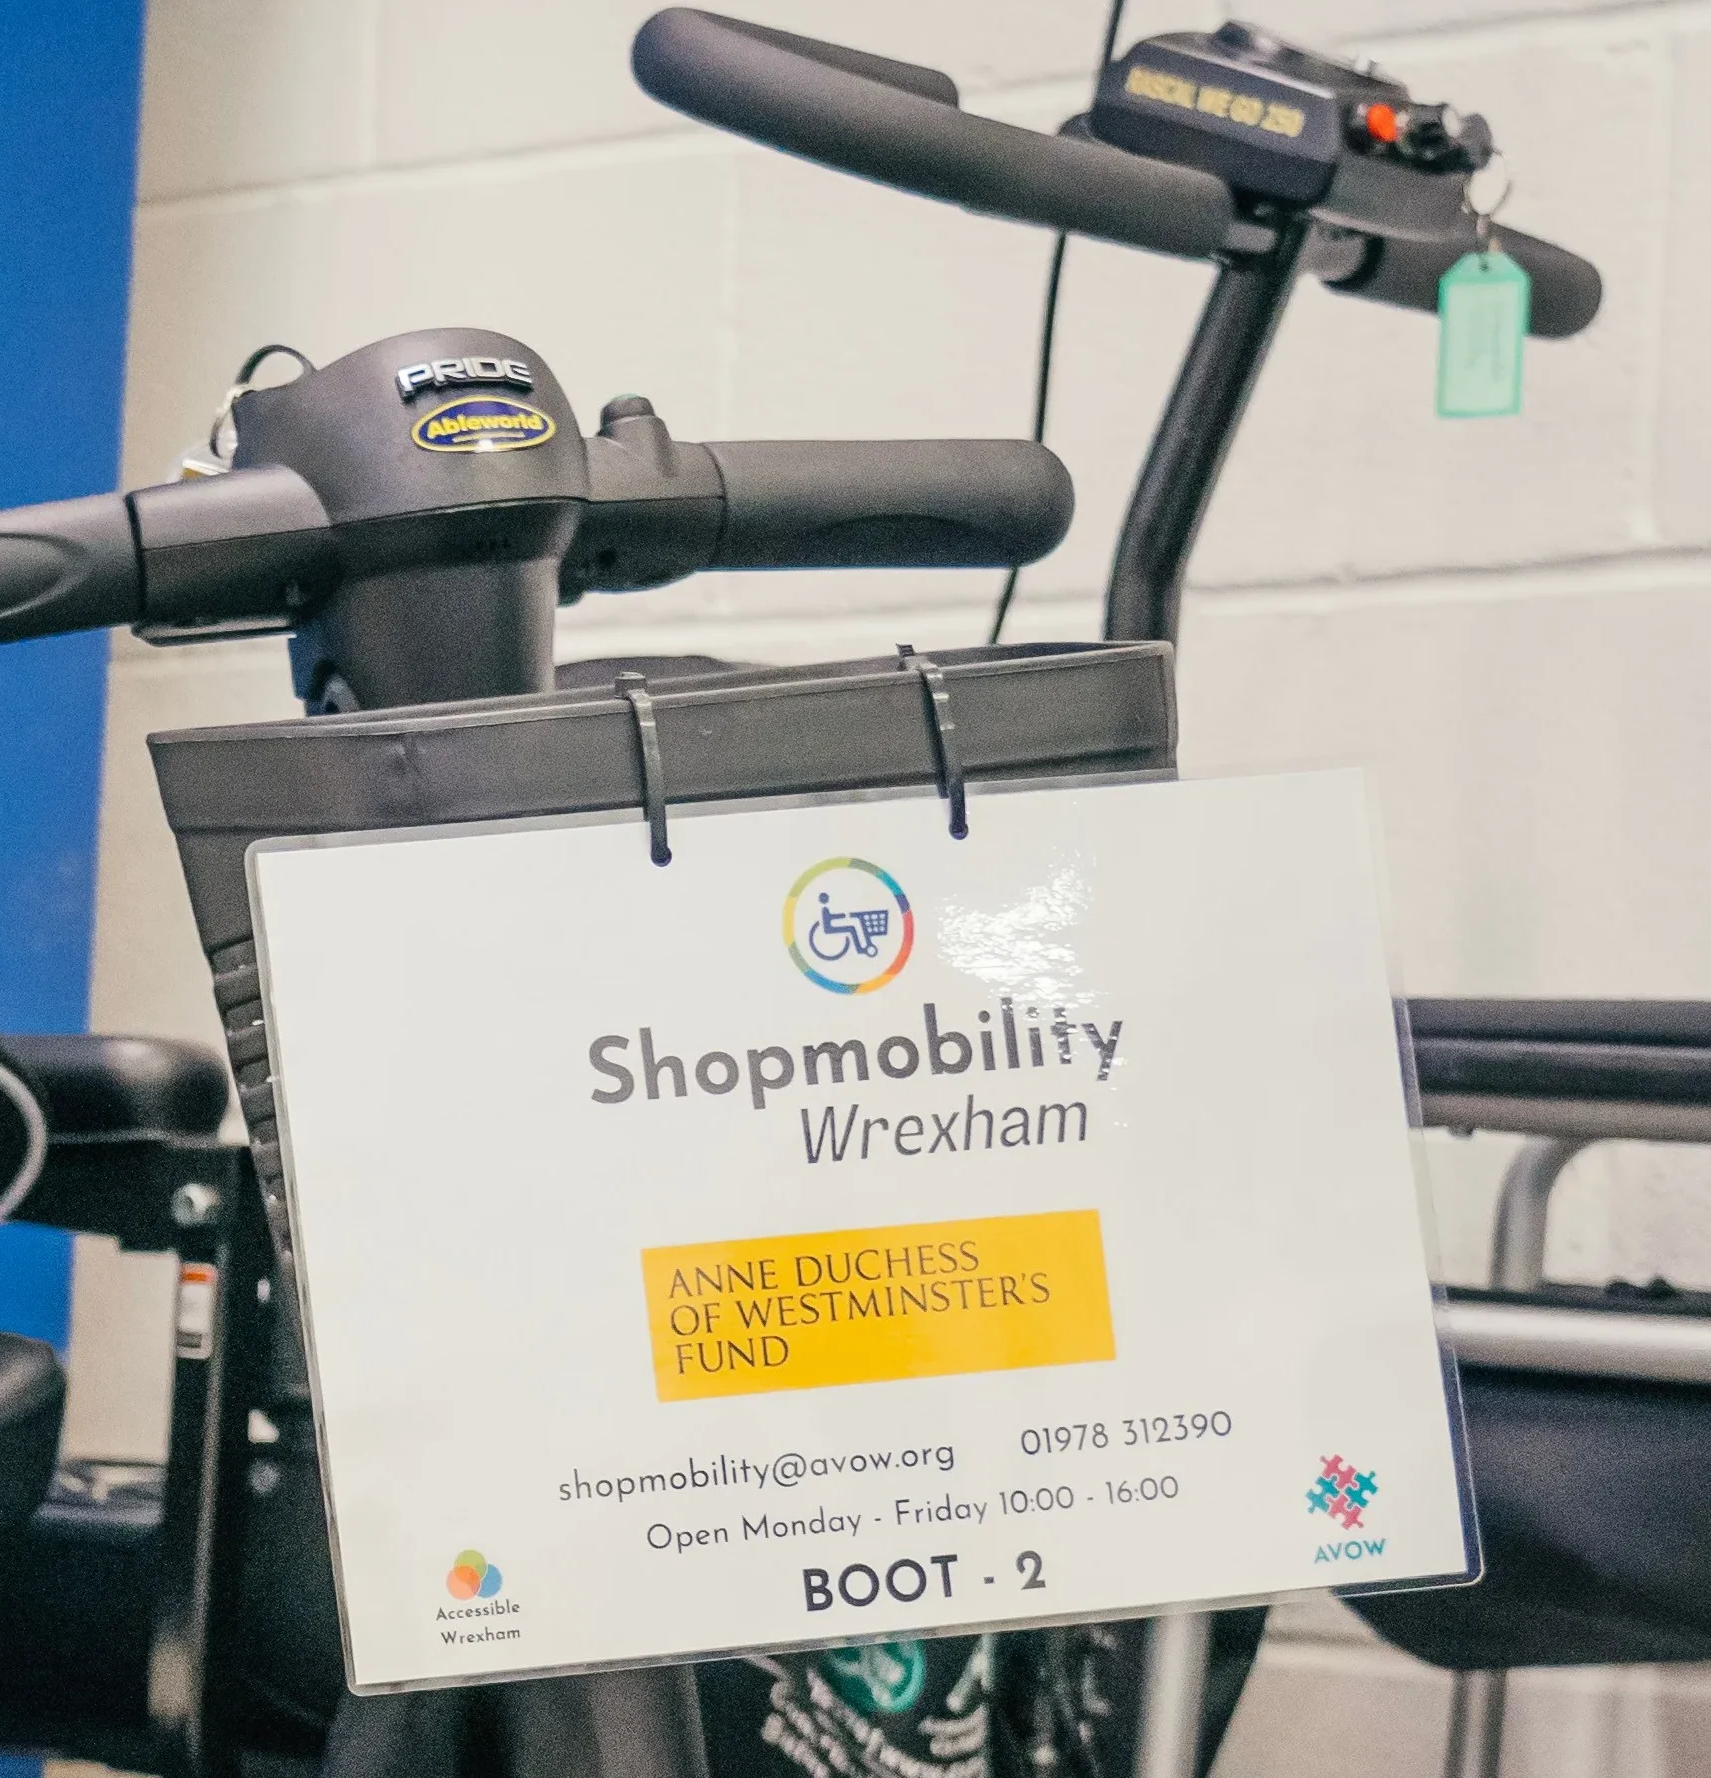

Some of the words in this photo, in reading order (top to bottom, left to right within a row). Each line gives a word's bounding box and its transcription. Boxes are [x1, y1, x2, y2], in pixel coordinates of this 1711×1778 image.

[397, 356, 535, 398] PRIDE
[427, 413, 544, 439] Ableworld
[588, 996, 1124, 1110] Shopmobility
[800, 1093, 1088, 1164] Wrexham
[668, 1257, 779, 1299] ANNE
[793, 1240, 980, 1288] DUCHESS
[669, 1302, 721, 1337] OF
[737, 1272, 1051, 1329] WESTMINSTER'S
[675, 1335, 789, 1376] FUND
[558, 1444, 956, 1502] shopmobility@avow.org
[1020, 1422, 1109, 1455] 01978
[1122, 1410, 1233, 1446] 312390
[646, 1523, 729, 1554] Open
[742, 1505, 862, 1541] Monday
[894, 1493, 988, 1526] Friday
[999, 1485, 1075, 1516] 10:00
[1104, 1475, 1180, 1505] 16:00
[802, 1553, 959, 1612] BOOT
[1015, 1549, 1047, 1591] 2
[1314, 1538, 1386, 1564] AVOW
[436, 1598, 520, 1621] Accessible
[441, 1626, 520, 1645] Wrexham
